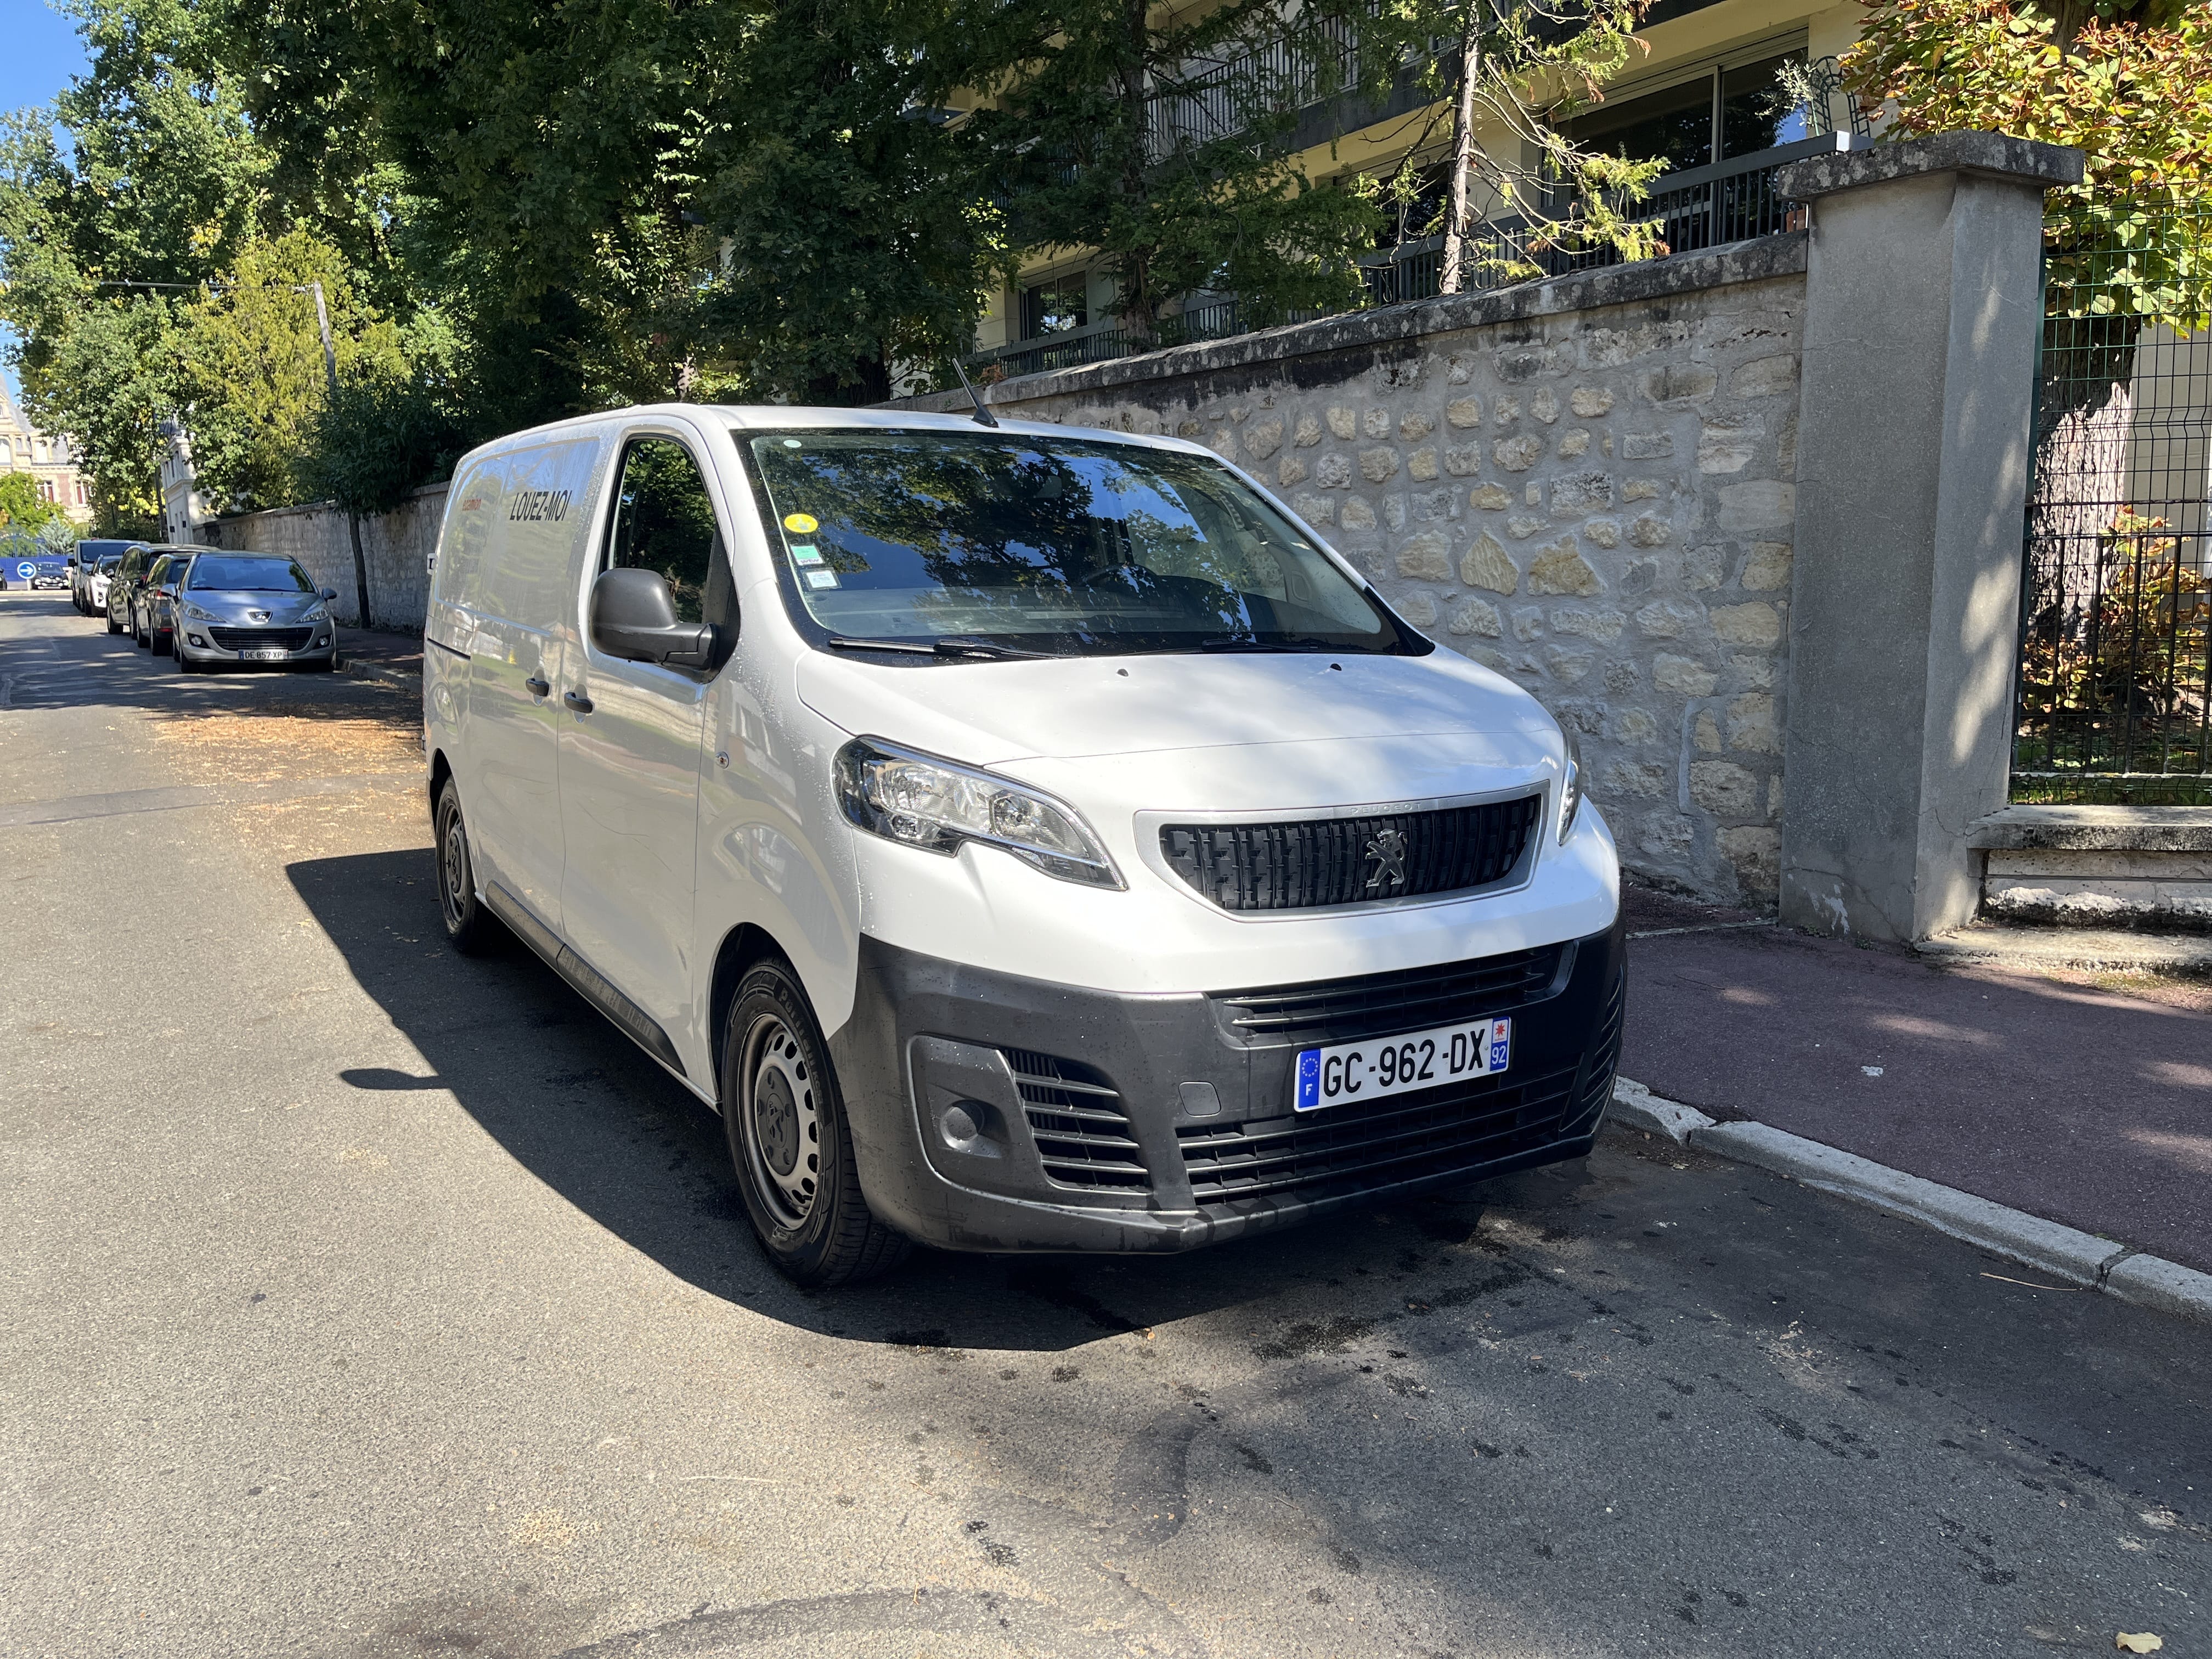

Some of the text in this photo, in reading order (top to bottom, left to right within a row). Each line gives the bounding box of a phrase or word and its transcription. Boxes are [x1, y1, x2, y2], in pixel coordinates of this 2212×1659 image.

[510, 490, 572, 521] LOUEZ-MOI
[1350, 802, 1422, 816] PEUGEOT
[1323, 1028, 1485, 1097] GC-962-DX
[1491, 1045, 1506, 1065] 92
[1305, 1083, 1313, 1096] F
